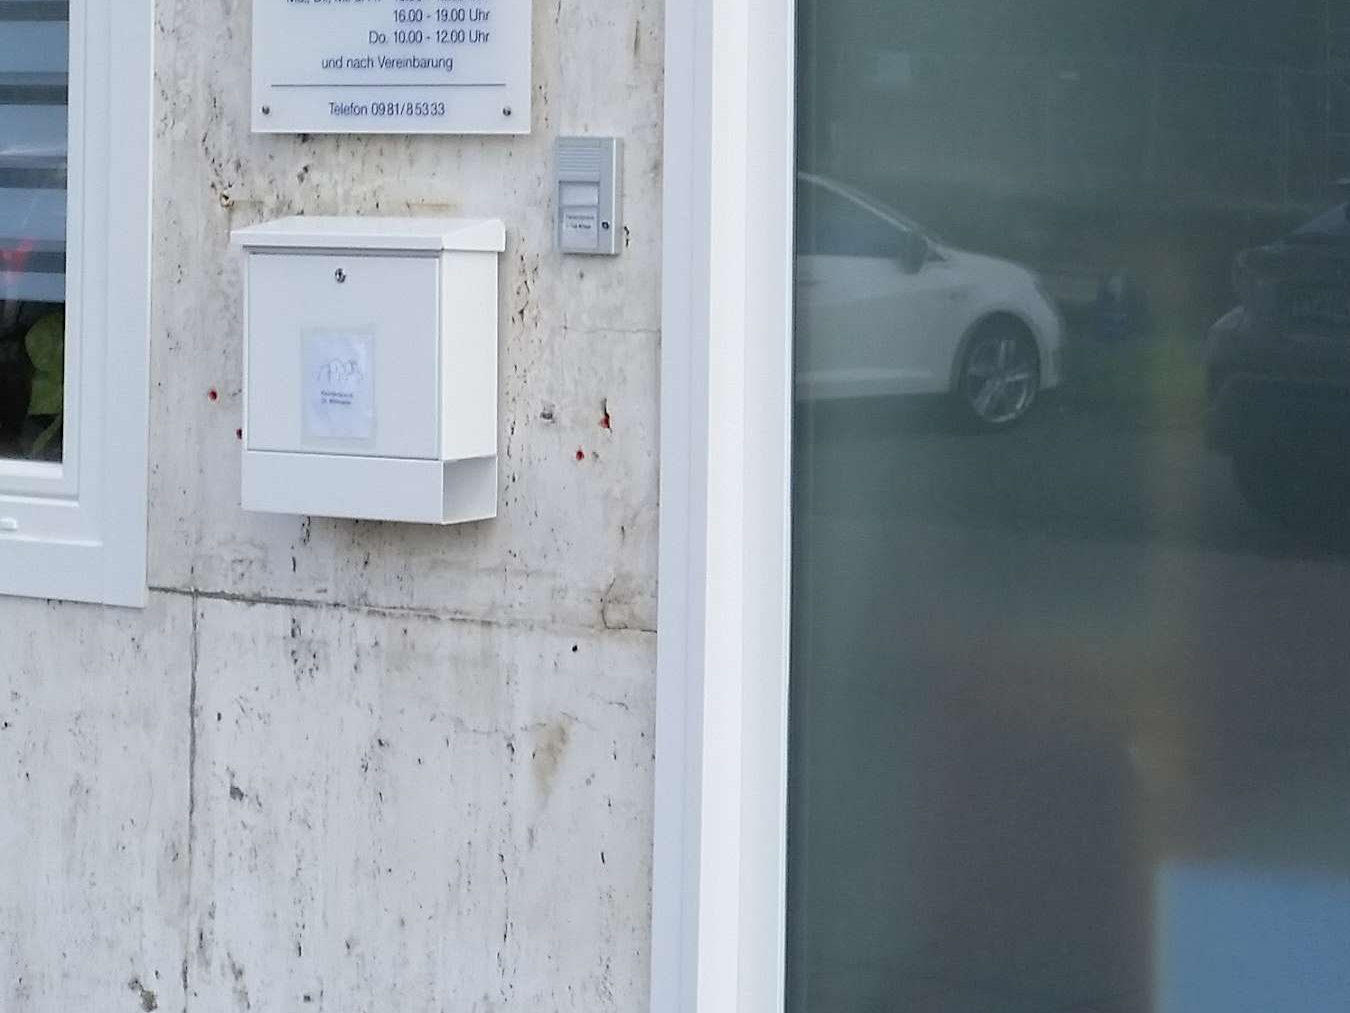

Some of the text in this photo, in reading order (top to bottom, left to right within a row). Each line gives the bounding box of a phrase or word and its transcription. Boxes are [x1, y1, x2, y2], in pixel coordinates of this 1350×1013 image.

[393, 9, 423, 23] 16.00
[436, 8, 466, 22] 19.00
[469, 8, 490, 22] Uhr
[368, 30, 388, 44] Do.
[393, 30, 423, 44] 10.00
[436, 29, 466, 44] 12.00
[468, 29, 490, 43] Uhr
[321, 55, 454, 72] und nach Vereinbarung
[329, 102, 367, 116] Telefon
